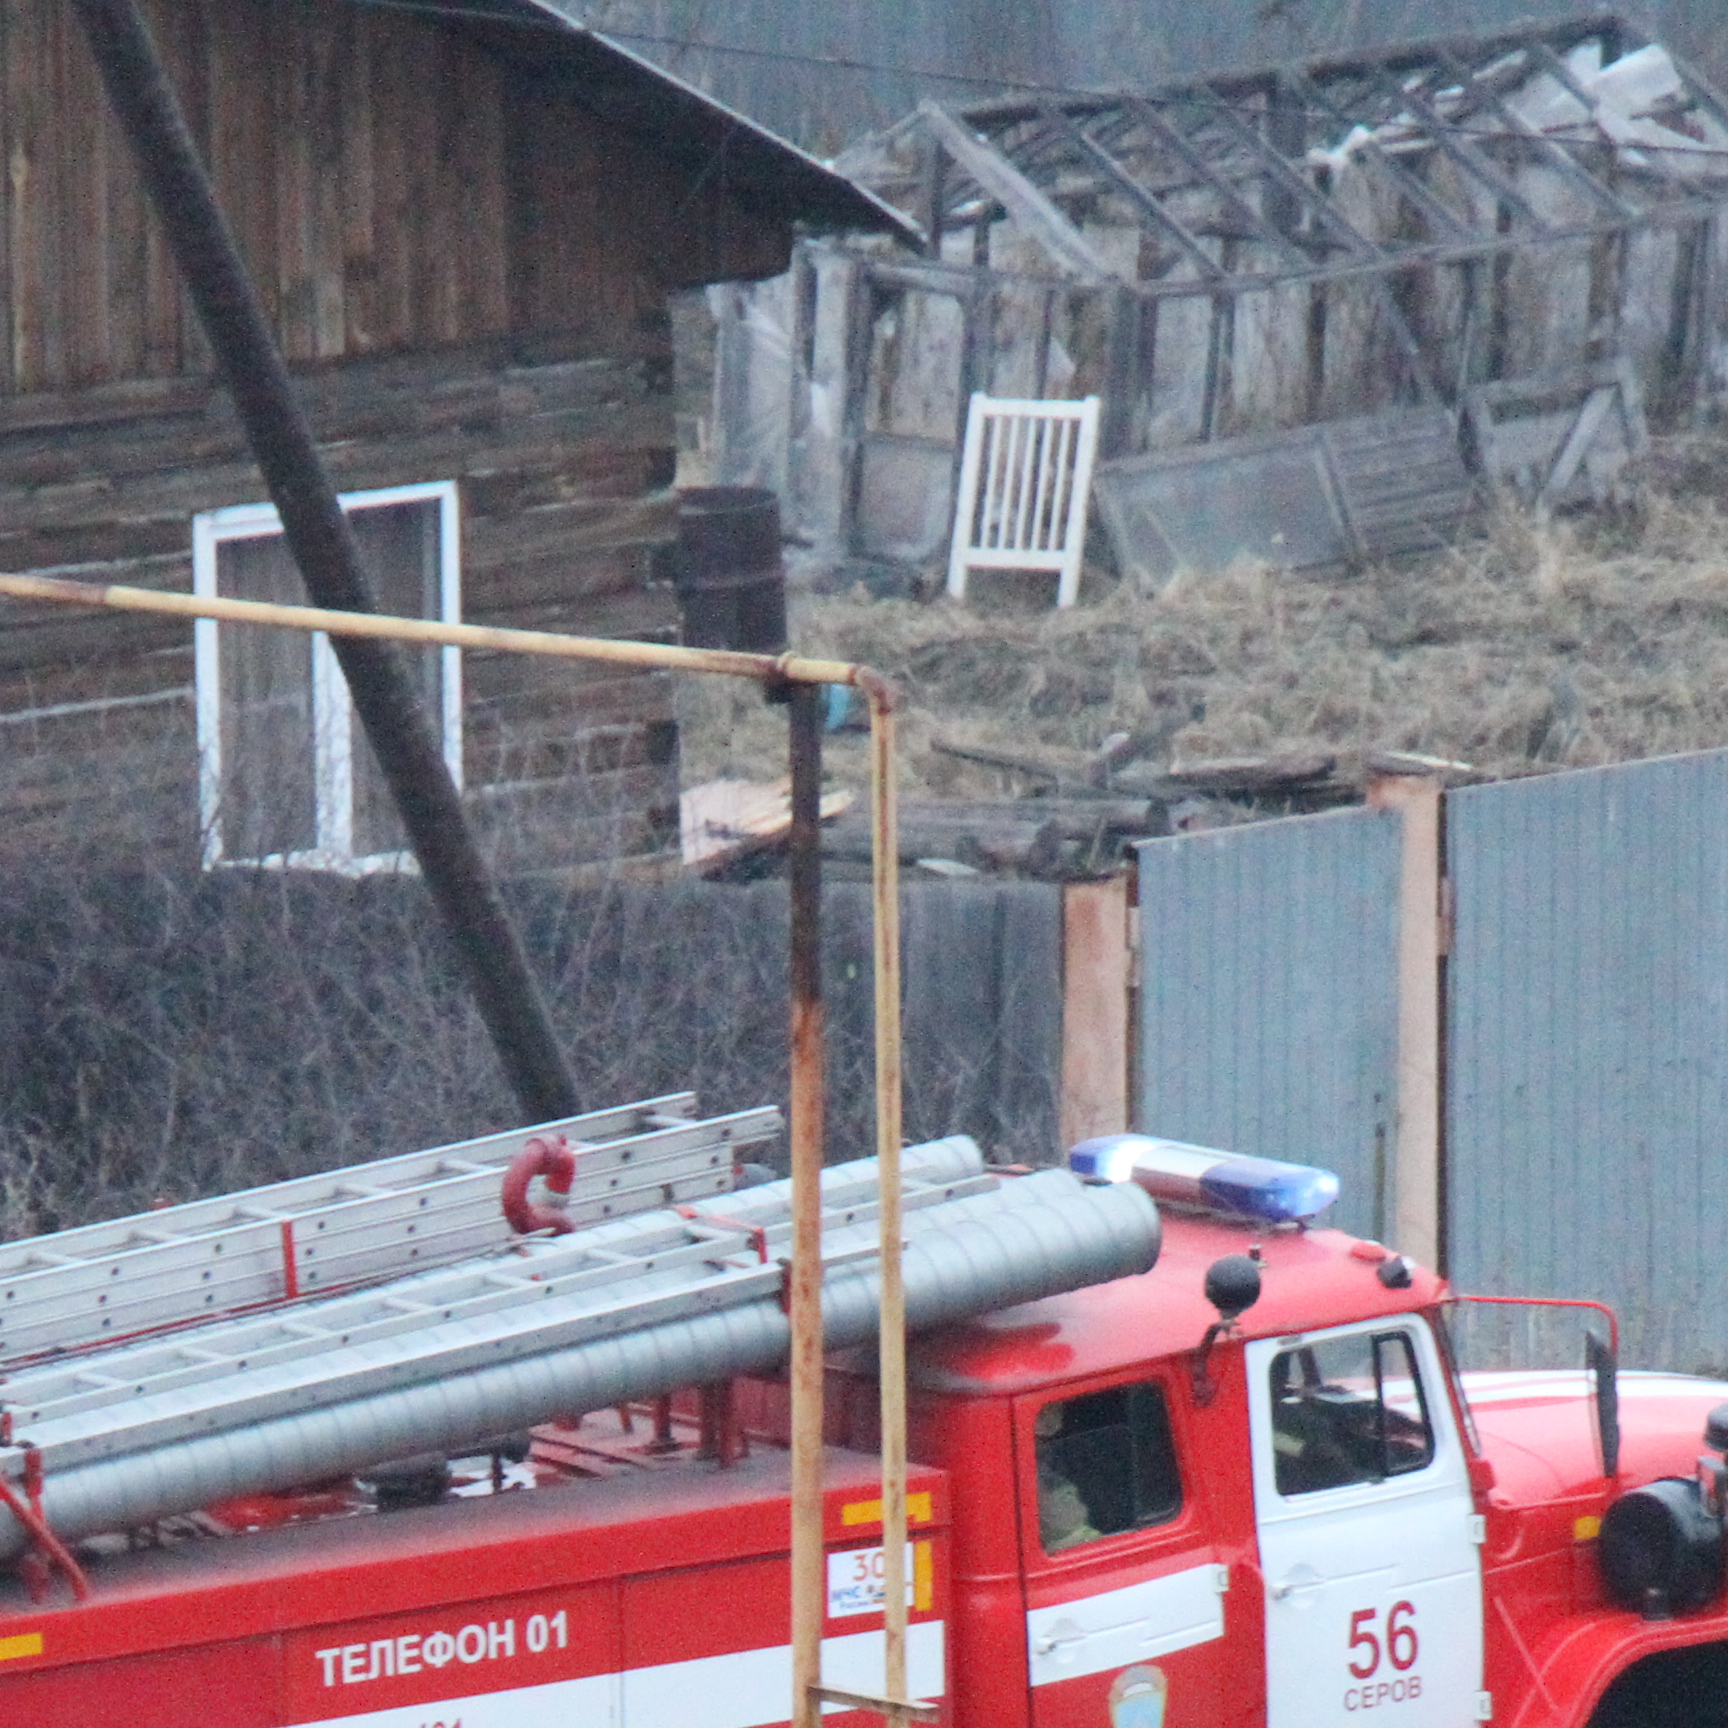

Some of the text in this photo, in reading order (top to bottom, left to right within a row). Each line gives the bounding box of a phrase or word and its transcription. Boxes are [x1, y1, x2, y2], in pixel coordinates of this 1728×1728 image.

[314, 1609, 569, 1687] ТЕЛЕФОН 01
[1348, 1599, 1419, 1680] 56
[1343, 1675, 1423, 1712] СЕРОВ
